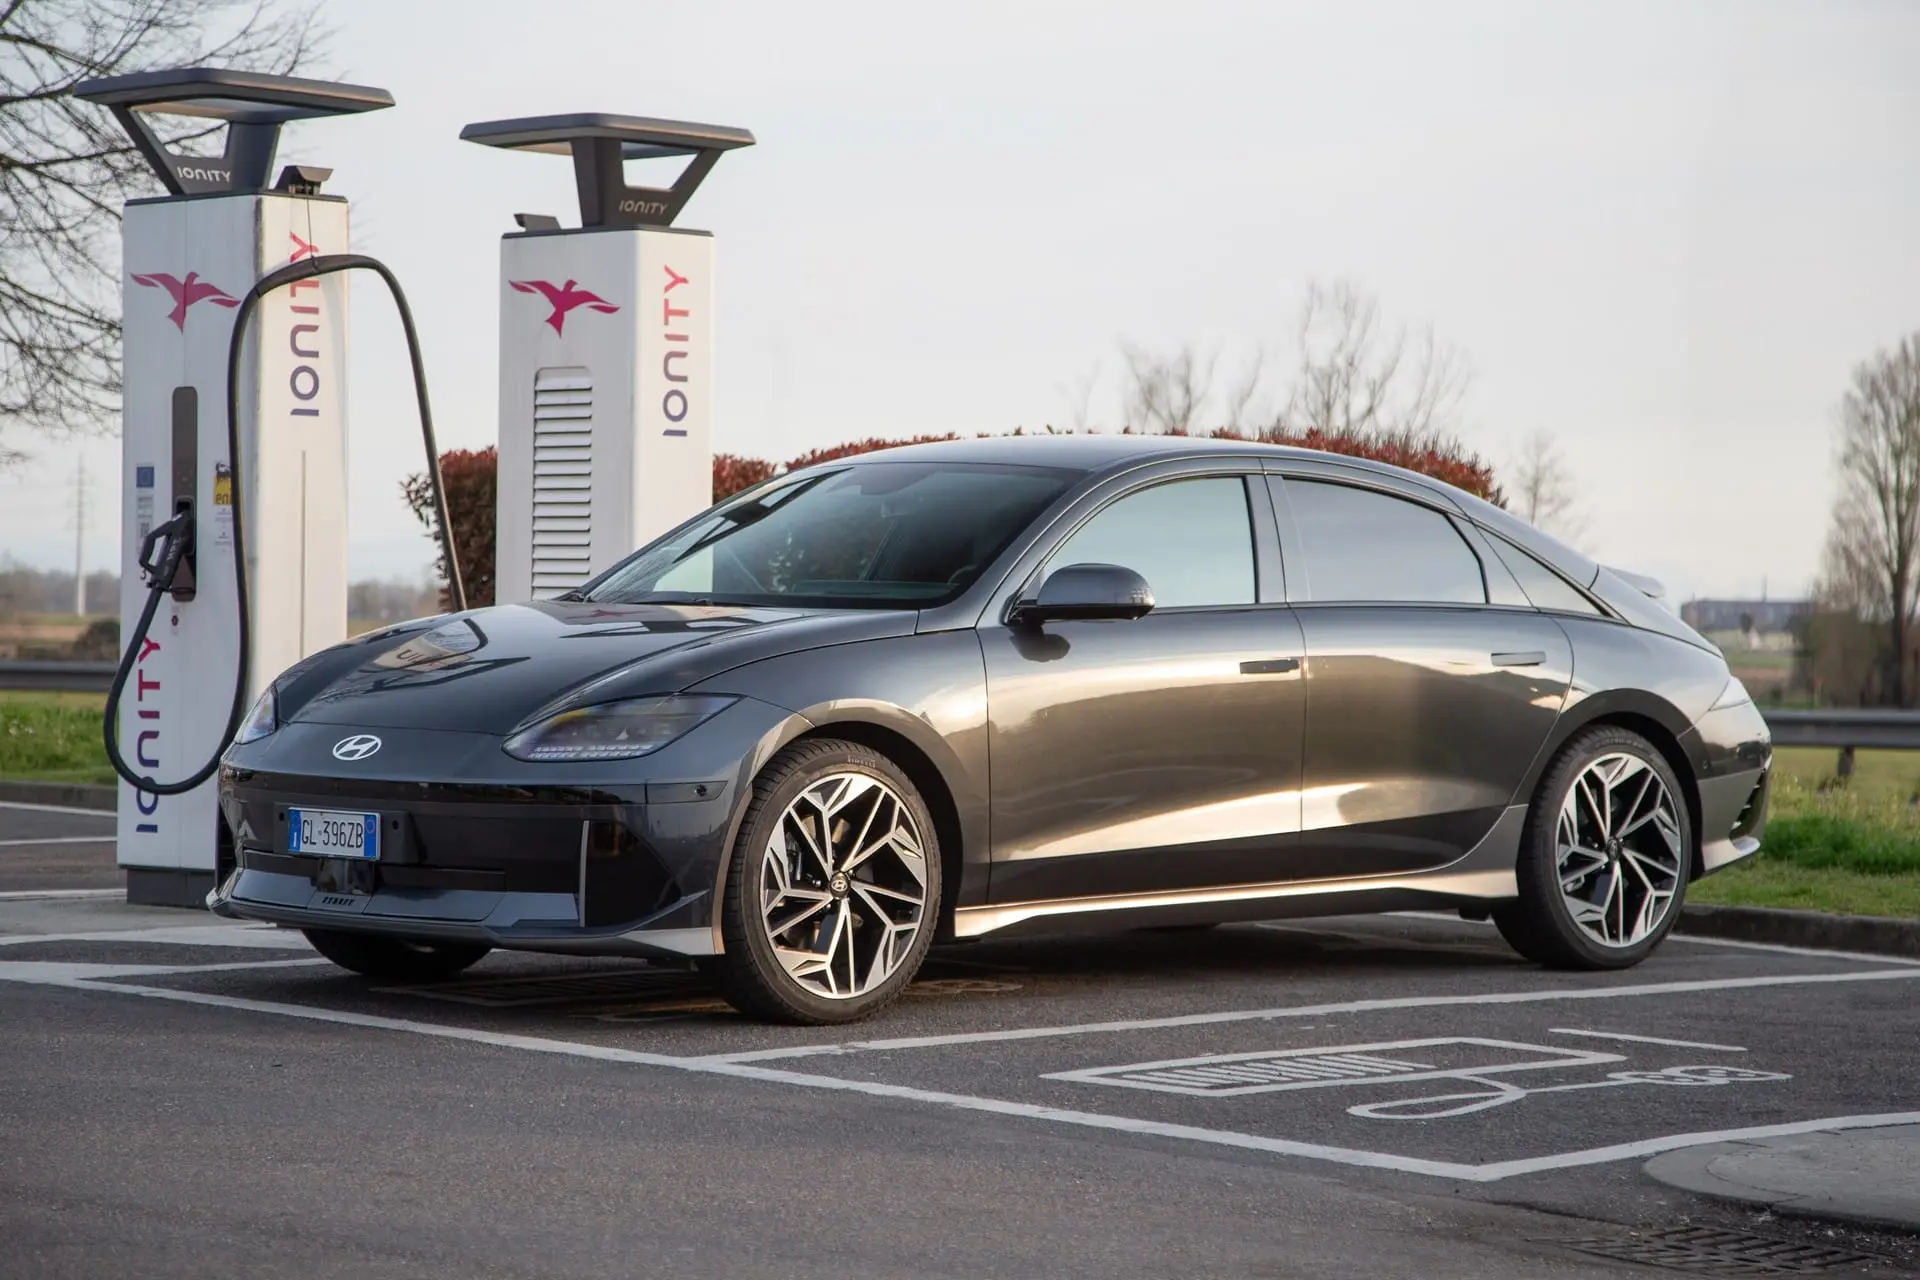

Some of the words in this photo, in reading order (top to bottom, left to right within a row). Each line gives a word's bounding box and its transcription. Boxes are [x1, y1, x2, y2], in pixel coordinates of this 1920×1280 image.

[177, 166, 231, 182] IONITY
[619, 200, 668, 215] IONITY
[663, 264, 689, 437] IONITY
[301, 819, 317, 846] GL
[322, 820, 364, 849] 396ZB
